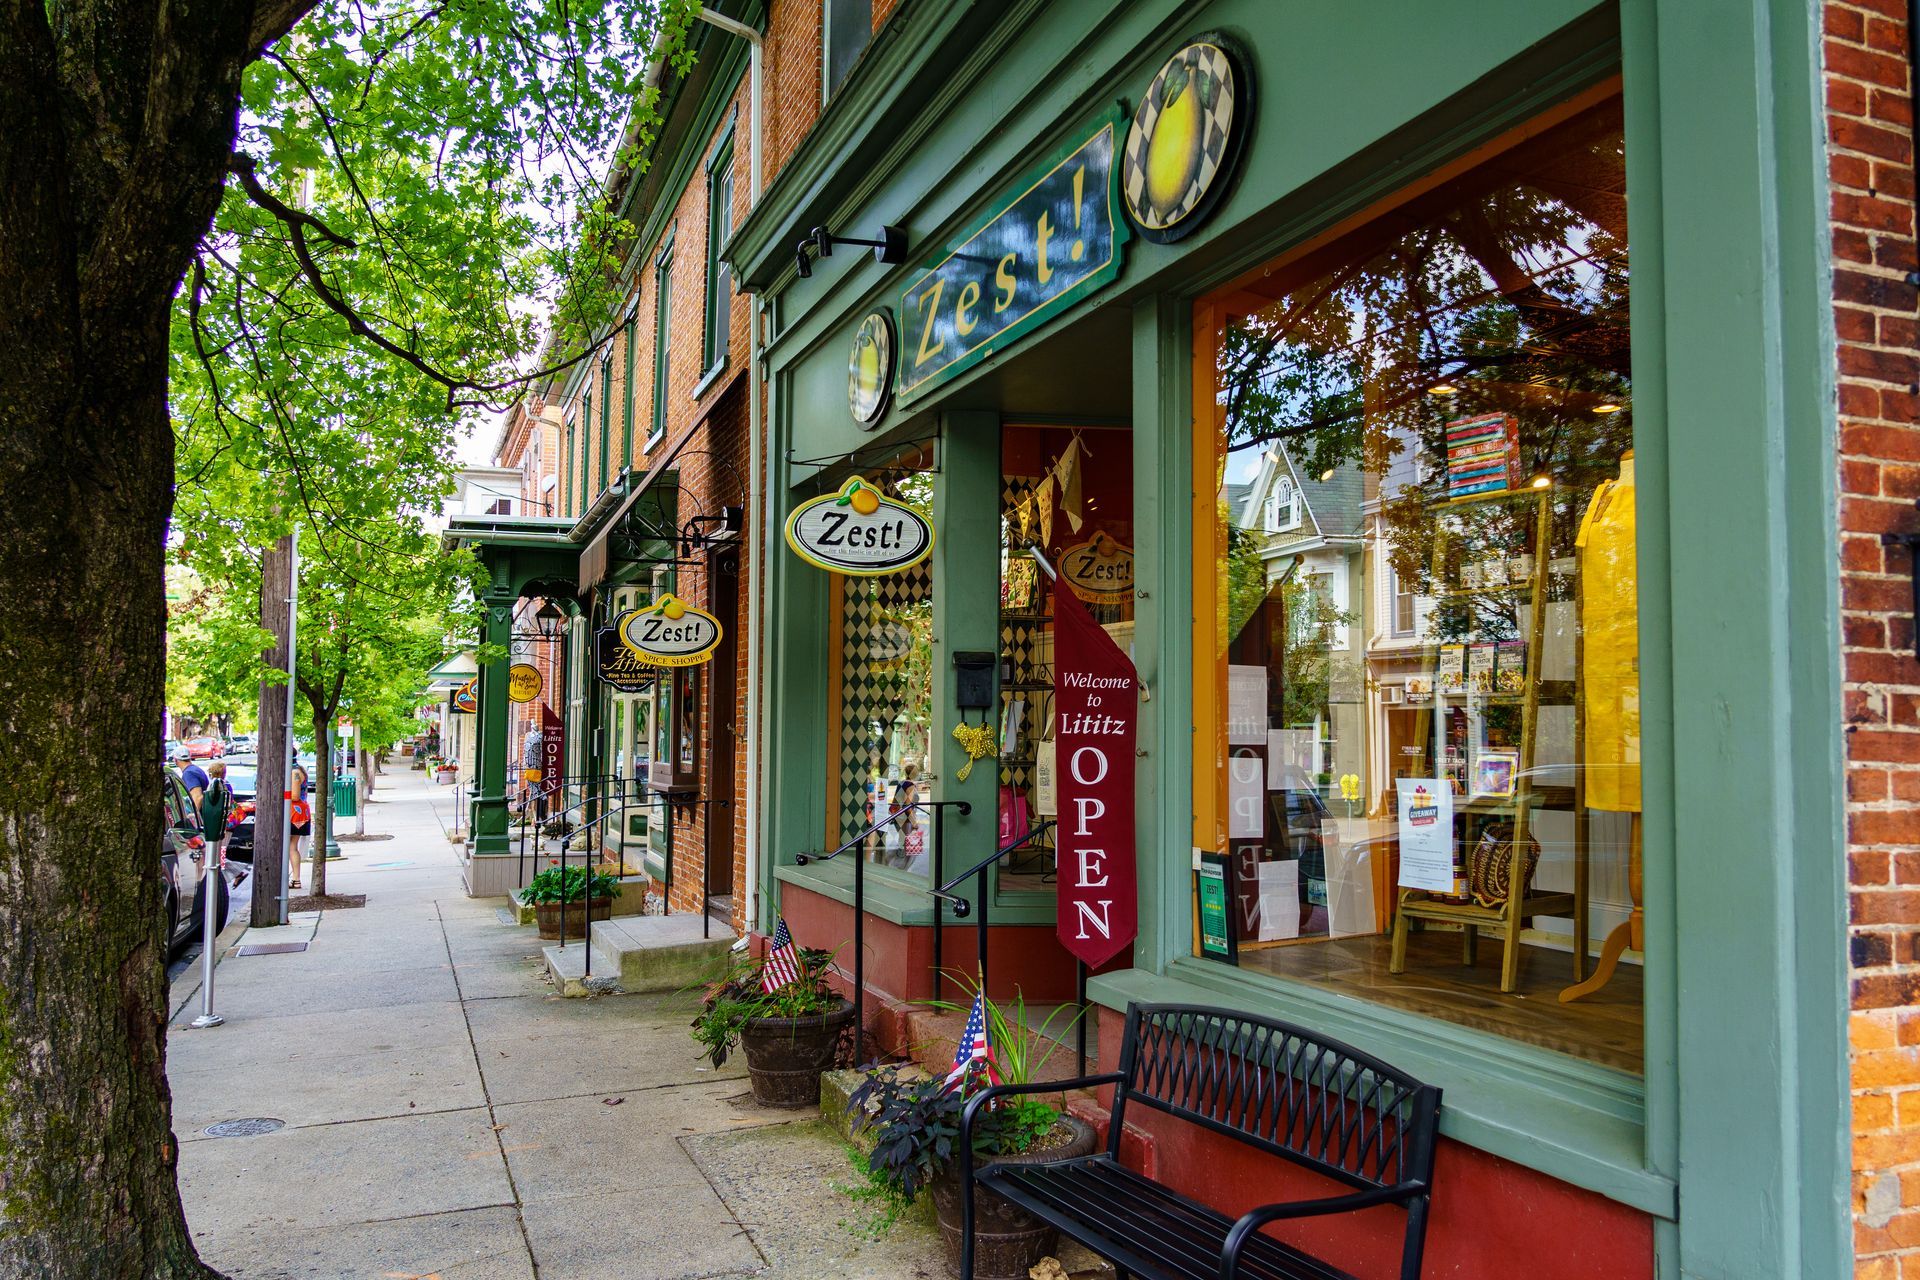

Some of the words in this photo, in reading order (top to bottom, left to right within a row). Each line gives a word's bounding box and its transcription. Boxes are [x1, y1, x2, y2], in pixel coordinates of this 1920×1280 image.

[914, 164, 1085, 368] Zest!
[817, 511, 904, 549] Zest!
[1076, 555, 1131, 580] Zest!
[642, 618, 701, 642] Zest!
[613, 647, 637, 659] Te
[643, 653, 668, 665] SPICE
[671, 653, 706, 665] SHOPPE
[1063, 672, 1131, 689] Welcome
[1087, 693, 1102, 707] to
[1061, 713, 1126, 735] Lititz
[546, 743, 558, 790] OPEN
[1409, 807, 1438, 819] GIVEAWAY
[1070, 746, 1113, 940] OPEN
